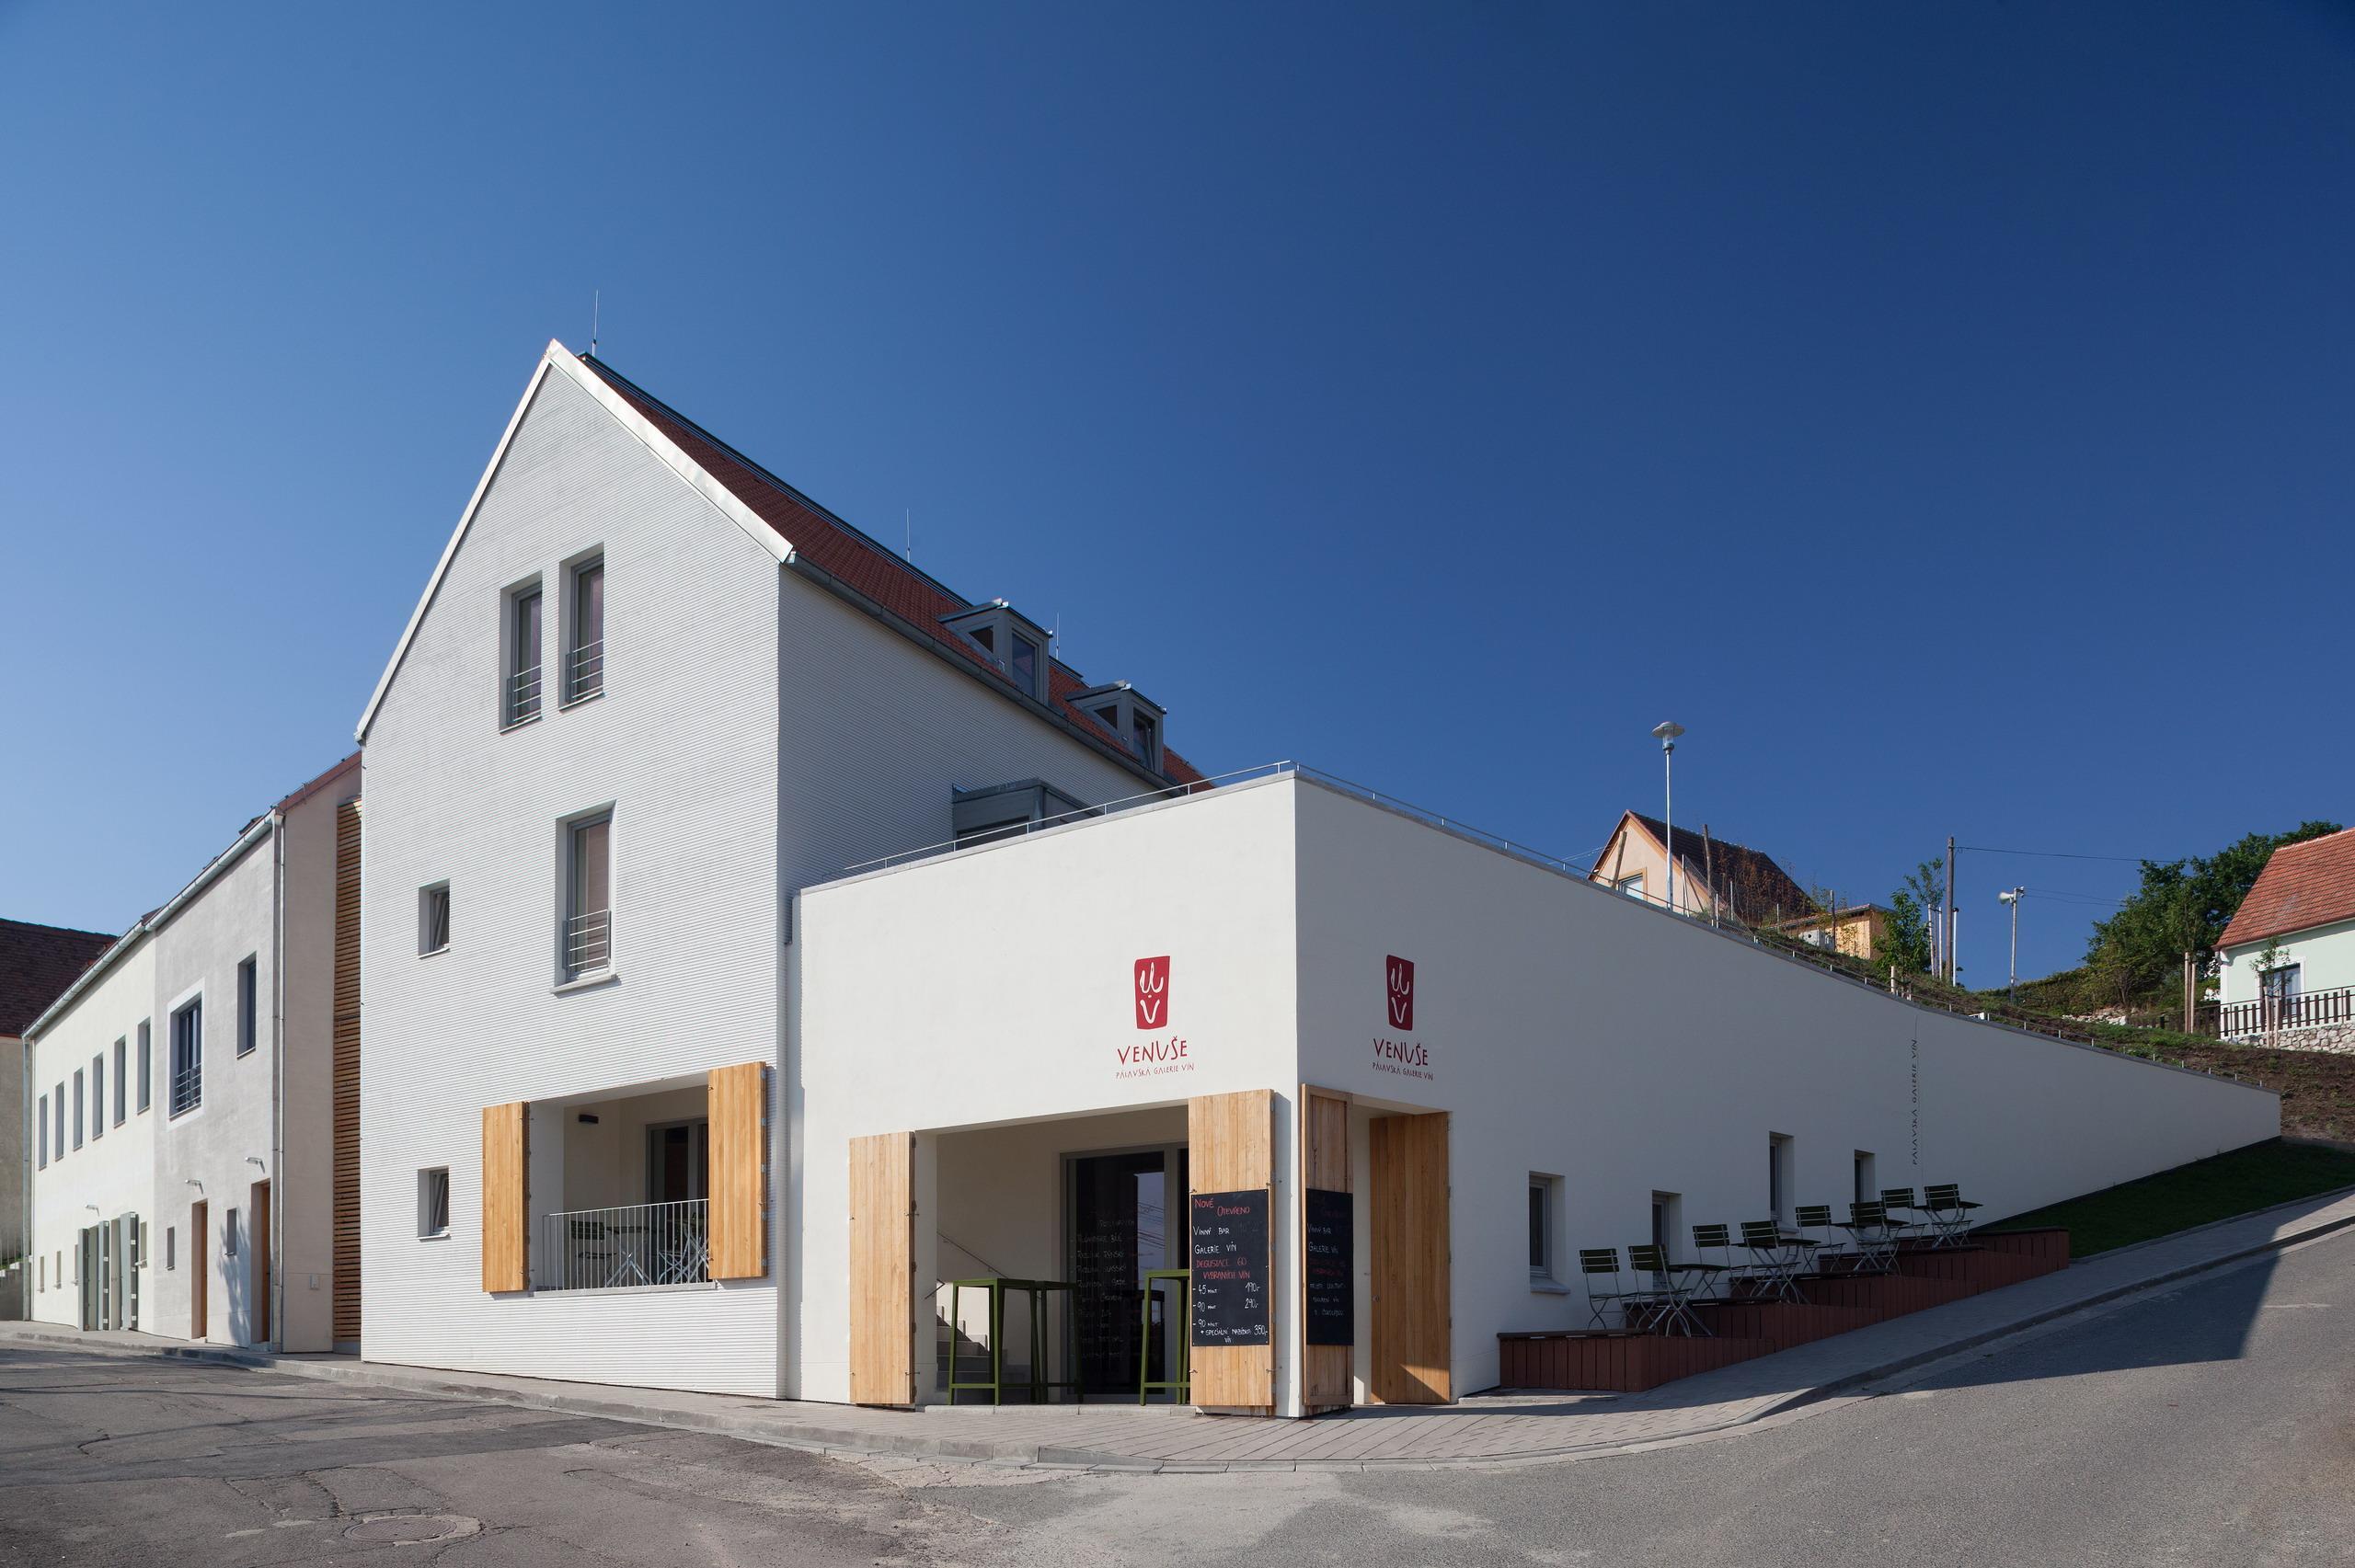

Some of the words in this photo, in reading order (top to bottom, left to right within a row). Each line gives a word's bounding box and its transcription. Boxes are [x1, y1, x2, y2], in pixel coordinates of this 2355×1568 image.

[1117, 1036, 1188, 1065] VENUŠE
[1373, 1037, 1428, 1066] VENUŠE
[1154, 1065, 1178, 1075] GALERIE
[1402, 1068, 1422, 1079] GALERIE
[1194, 1197, 1214, 1208] NOVÉ
[1192, 1226, 1212, 1236] VINNÝ
[1218, 1227, 1230, 1235] BAR
[1194, 1244, 1220, 1254] GALERIE
[1198, 1284, 1207, 1295] 45
[1197, 1301, 1206, 1312] 90
[1198, 1318, 1206, 1328] 90
